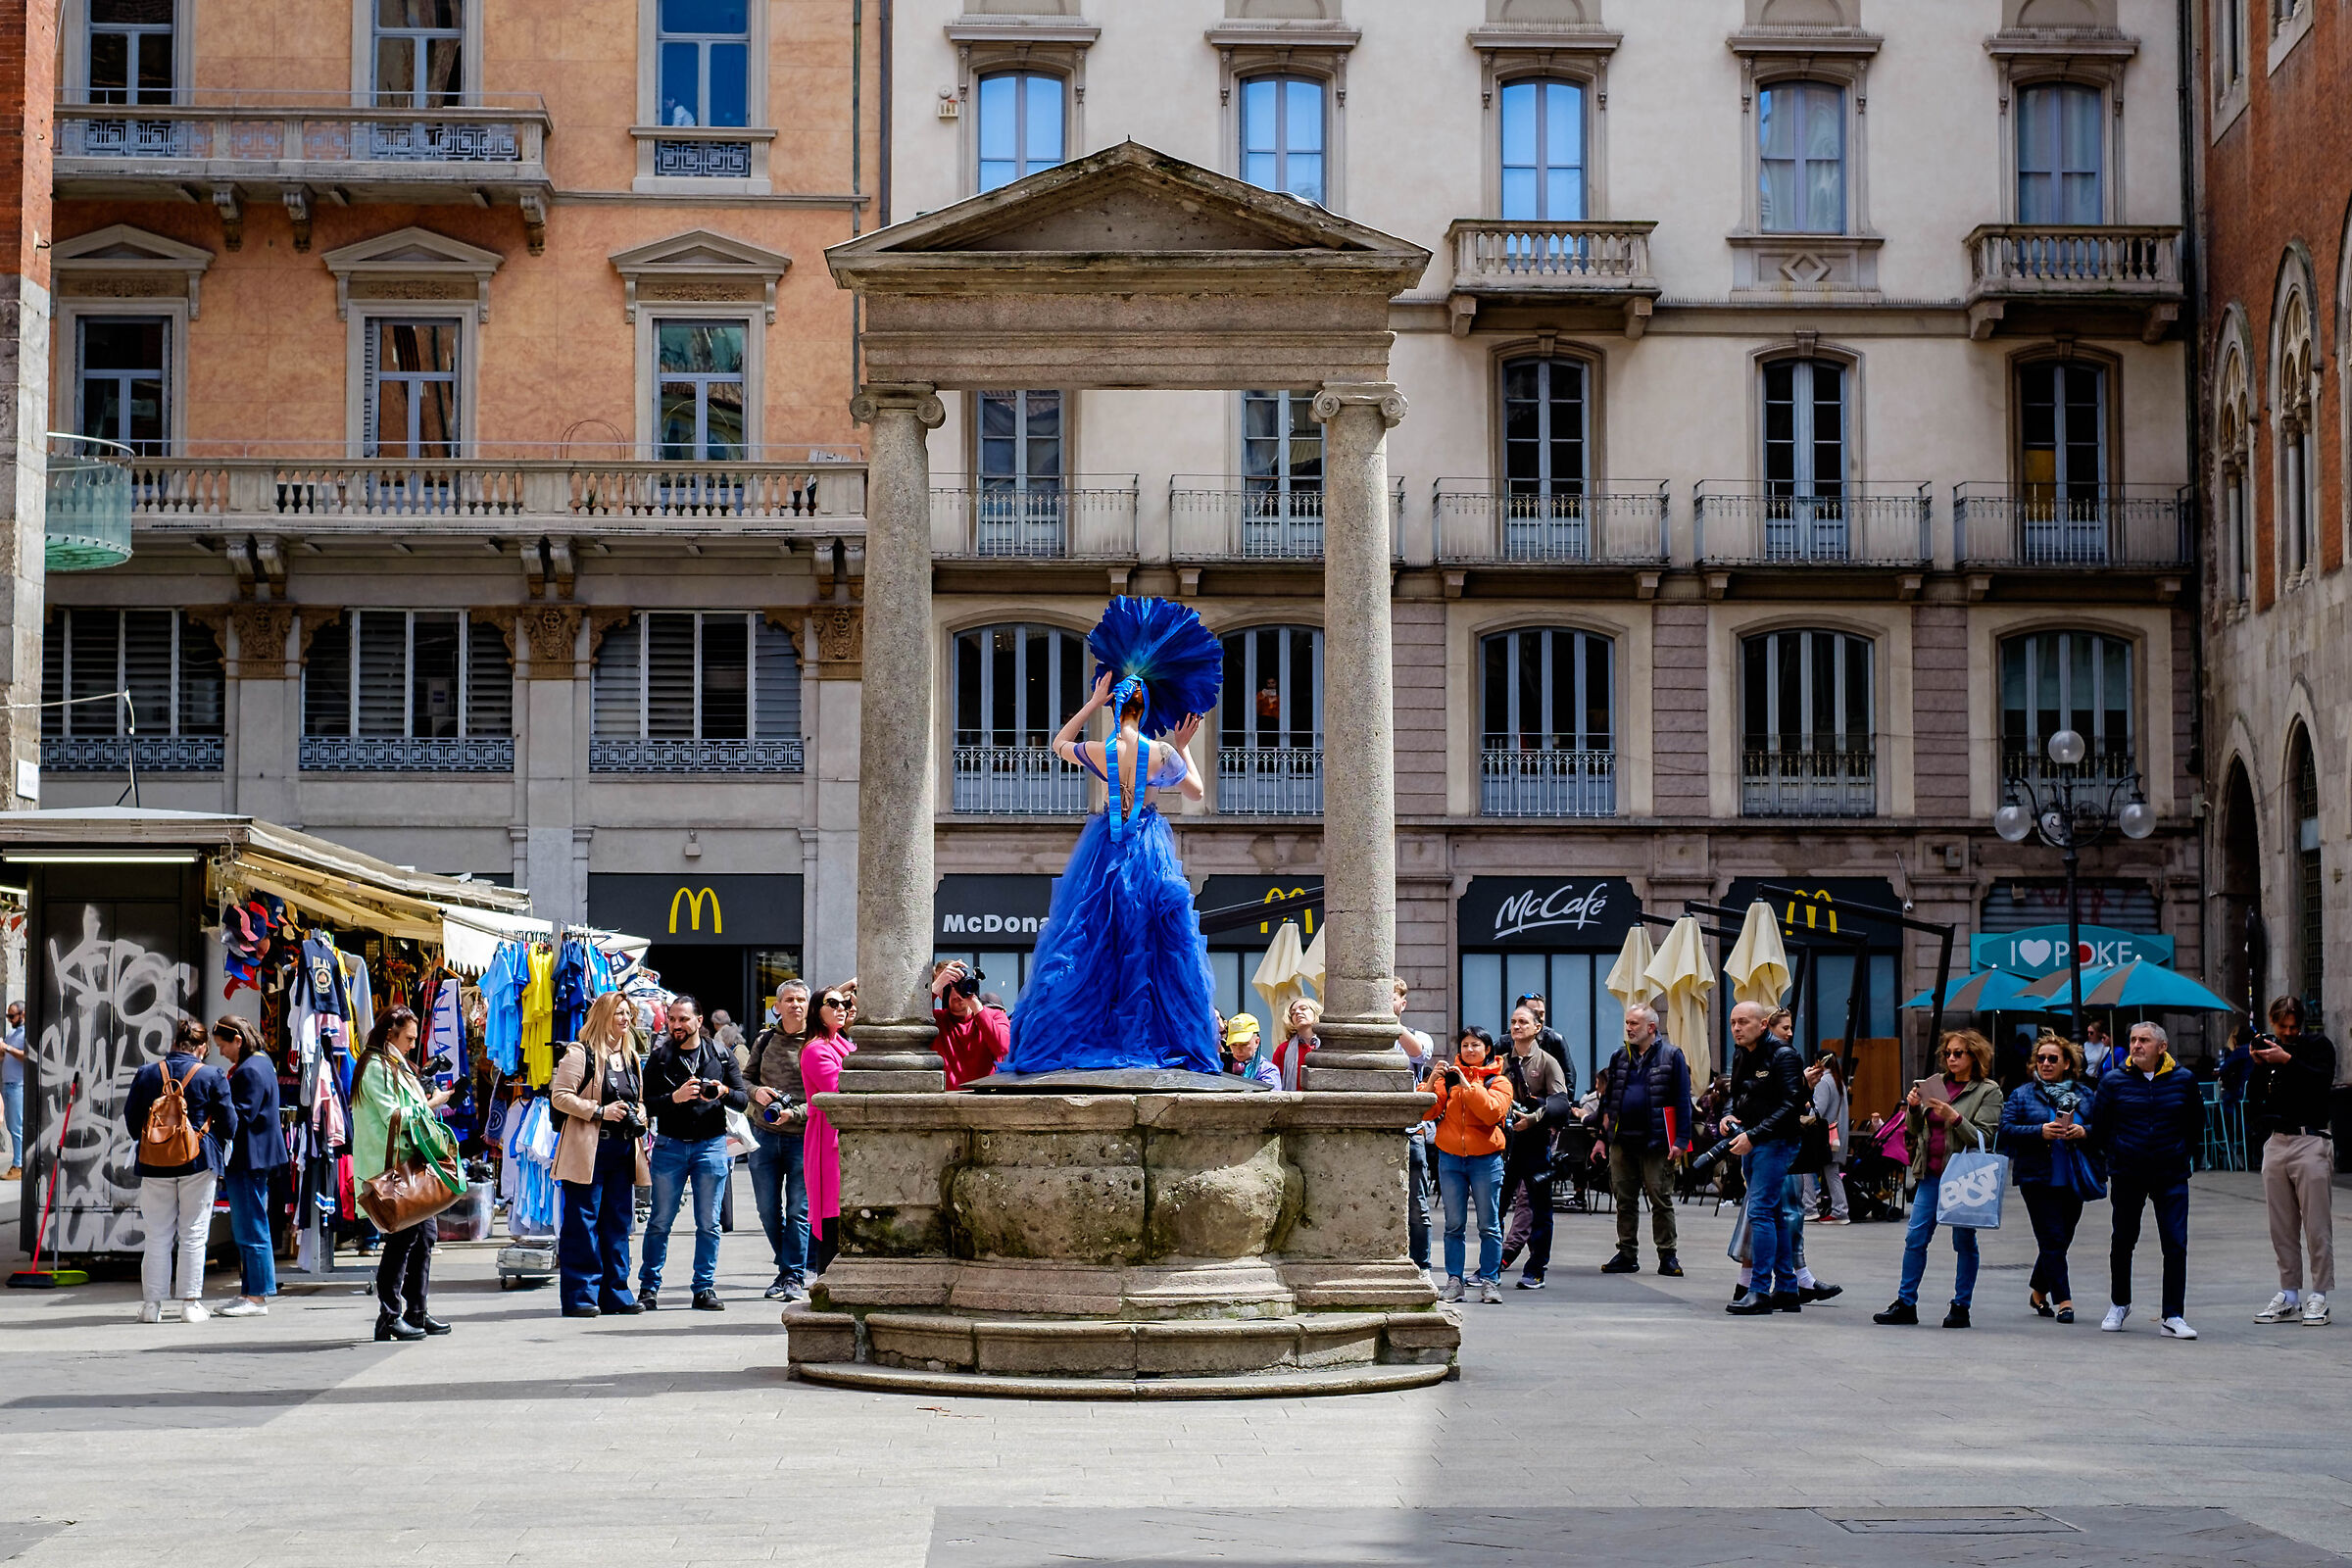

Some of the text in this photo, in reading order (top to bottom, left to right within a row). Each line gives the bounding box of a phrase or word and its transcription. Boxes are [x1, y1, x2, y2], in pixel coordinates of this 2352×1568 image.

[1494, 883, 1607, 933] McCafé
[2010, 941, 2132, 966] I POKE
